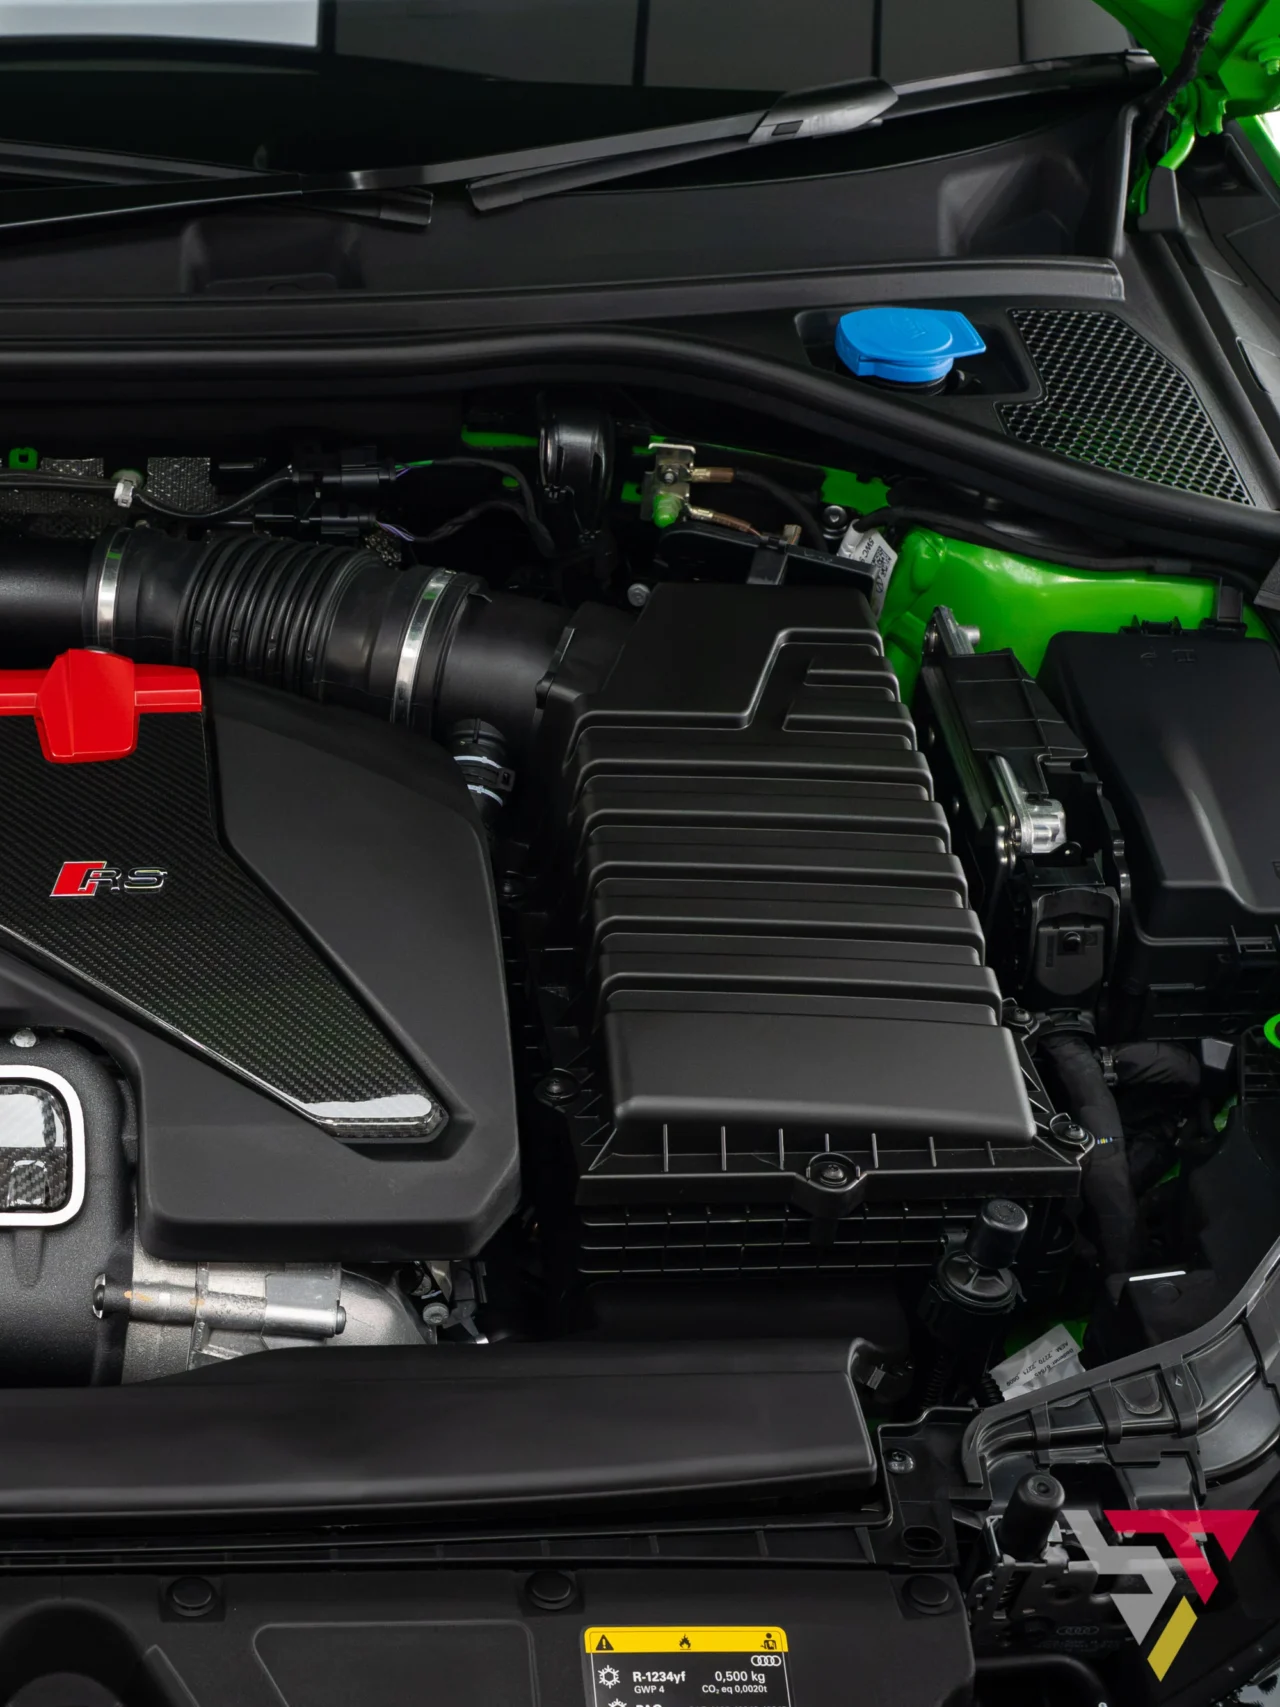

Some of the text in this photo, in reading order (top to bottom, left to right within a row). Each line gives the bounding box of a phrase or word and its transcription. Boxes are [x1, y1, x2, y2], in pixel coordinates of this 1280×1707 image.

[77, 866, 168, 894] RS
[632, 1671, 766, 1684] R-1234yf 0,500 kg
[634, 1686, 657, 1694] GWP
[722, 1686, 733, 1694] eq
[734, 1685, 768, 1694] 0,0020t
